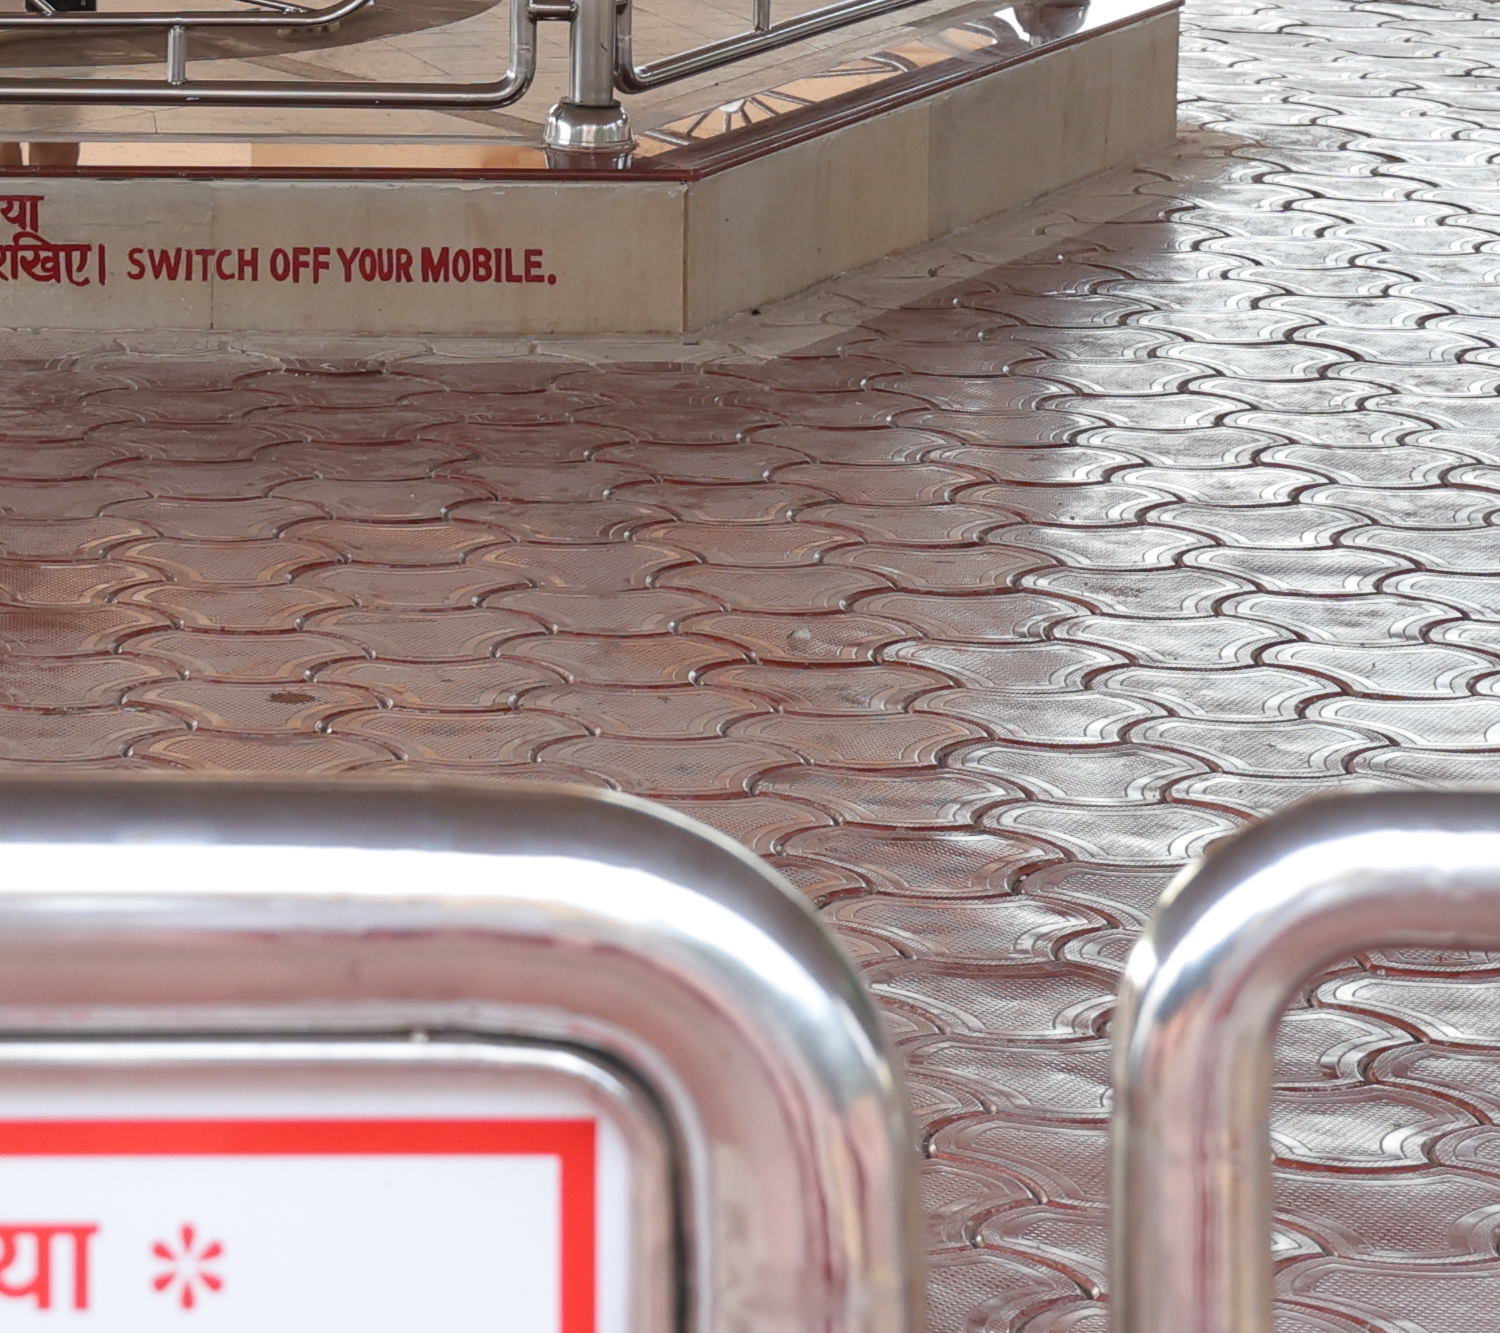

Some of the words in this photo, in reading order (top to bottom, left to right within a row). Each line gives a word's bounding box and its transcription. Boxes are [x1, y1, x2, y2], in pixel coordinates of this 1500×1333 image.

[128, 248, 258, 282] SWITCH
[270, 247, 331, 284] OFF
[337, 247, 414, 283] YOUR
[422, 247, 557, 285] MOBILE.
